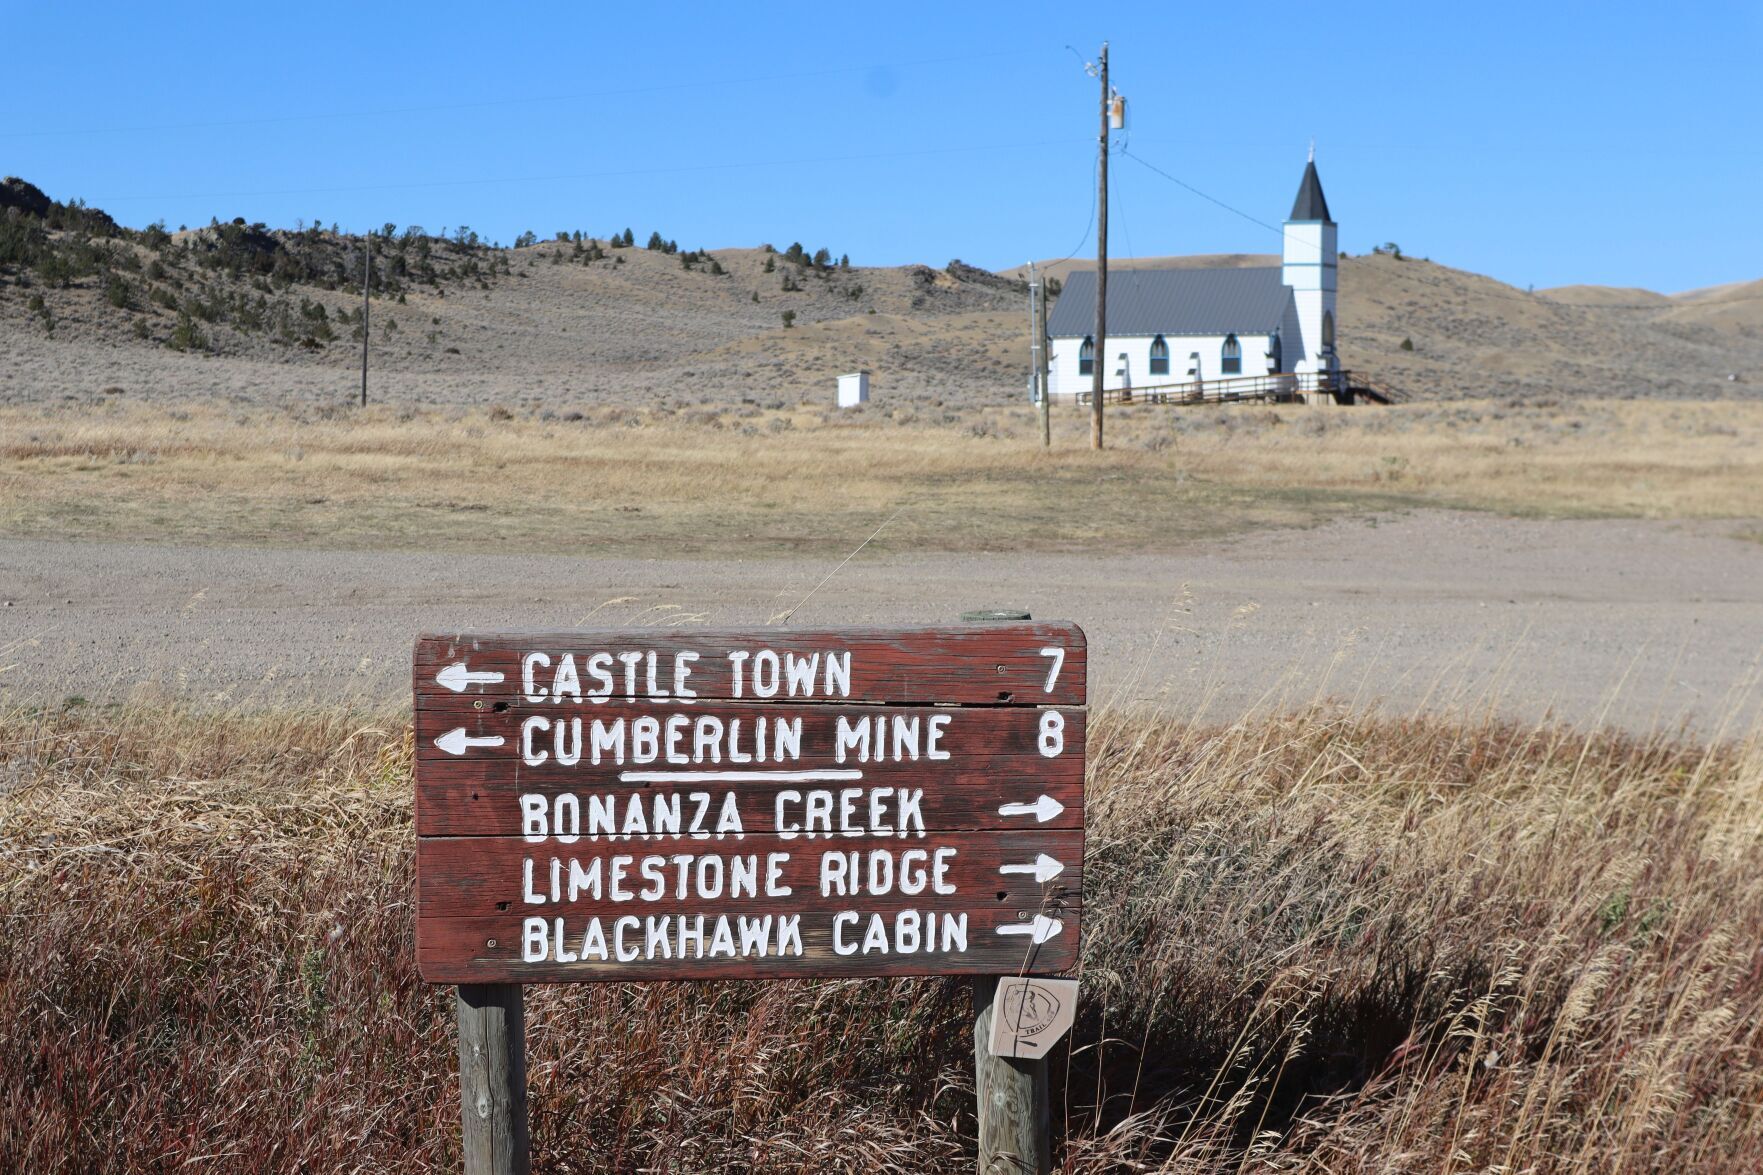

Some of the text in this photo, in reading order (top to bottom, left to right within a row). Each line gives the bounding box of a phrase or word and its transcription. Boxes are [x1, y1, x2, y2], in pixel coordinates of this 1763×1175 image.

[521, 647, 1065, 704] CASTLE TOWN 7
[522, 709, 1065, 767] CUMBERLIN MINE 8
[520, 786, 927, 844] BONANZA CREEK
[523, 847, 957, 905] LIMESTONE RIDGE
[523, 909, 968, 963] BLACKHAWK CABIN
[1025, 1023, 1047, 1035] TRAIL
